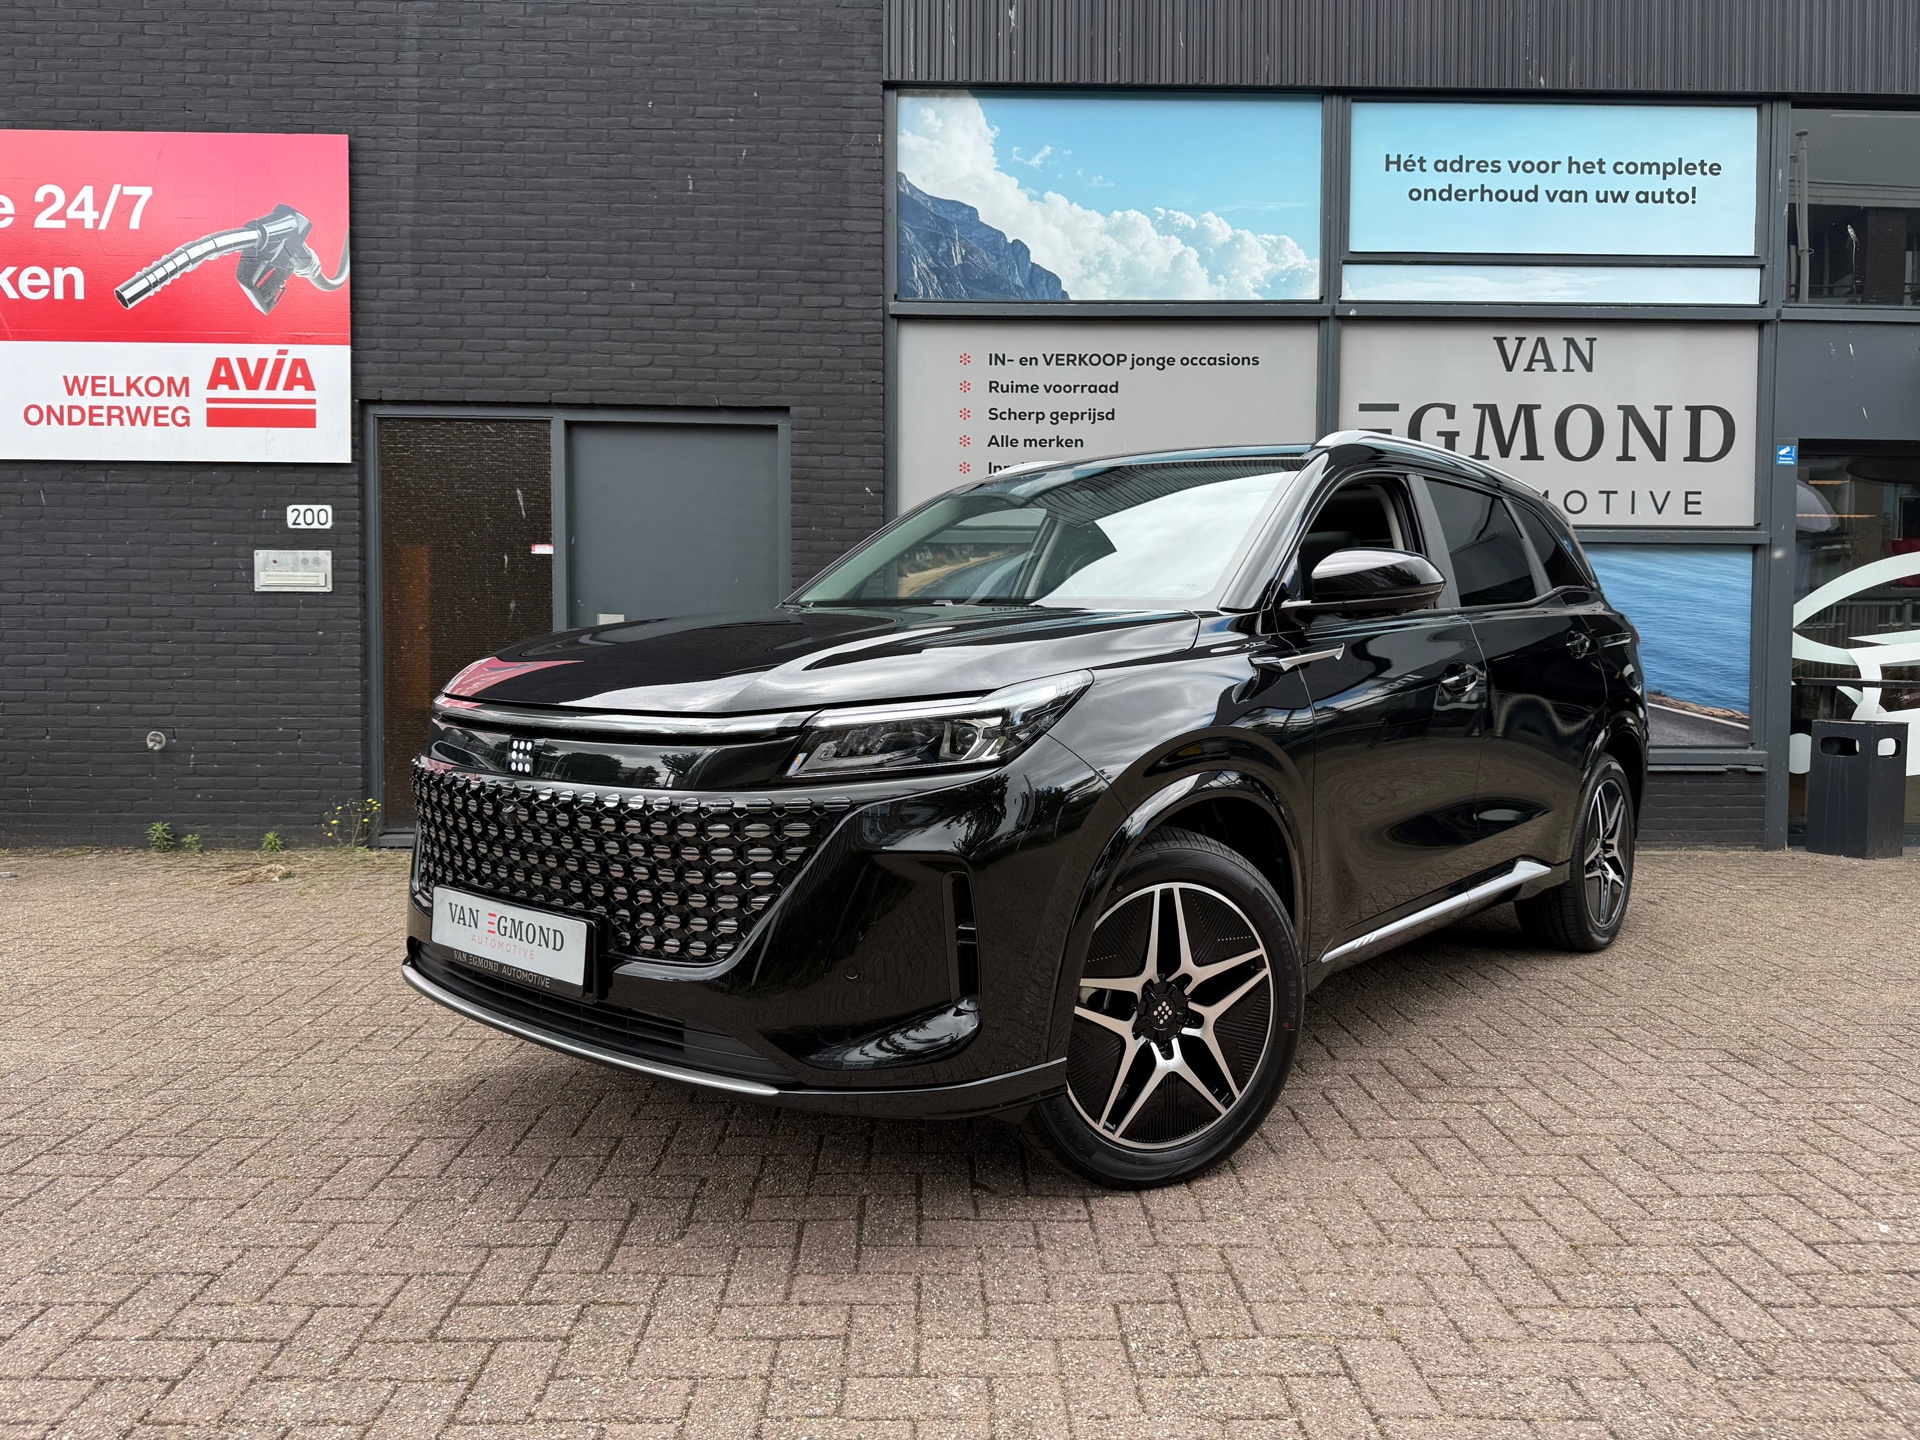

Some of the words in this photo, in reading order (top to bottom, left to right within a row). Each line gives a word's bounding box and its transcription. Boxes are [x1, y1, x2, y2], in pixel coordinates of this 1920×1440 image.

[1385, 154, 1427, 173] Hét
[1434, 155, 1502, 174] adres
[1508, 159, 1562, 174] voor
[1568, 156, 1607, 175] het
[1613, 157, 1722, 181] complete
[1408, 184, 1539, 203] onderhoud
[1545, 189, 1588, 204] van
[1596, 189, 1630, 204] uw
[1635, 187, 1697, 205] auto!
[33, 183, 153, 230] 24/7
[988, 352, 1015, 366] IN-
[1019, 356, 1039, 367] en
[1042, 353, 1128, 367] VERKOOP
[1129, 353, 1176, 371] jonge
[1180, 353, 1260, 367] occasions
[1493, 336, 1597, 372] VAN
[63, 375, 190, 397] WELKOM
[988, 380, 1040, 394] Ruime
[1043, 380, 1119, 394] voorraad
[23, 404, 191, 427] ONDERWEG
[988, 407, 1046, 425] Scherp
[1050, 408, 1116, 426] geprijsd
[987, 435, 1020, 448] Alle
[1023, 435, 1084, 448] merken
[291, 508, 329, 526] 200
[448, 902, 480, 930] VAN
[487, 912, 565, 952] EGMOND
[471, 934, 536, 960] AUTOMOTIVE
[453, 950, 468, 963] VAN
[468, 956, 499, 973] EGMOND
[501, 966, 551, 988] AUTOMOTIVE
